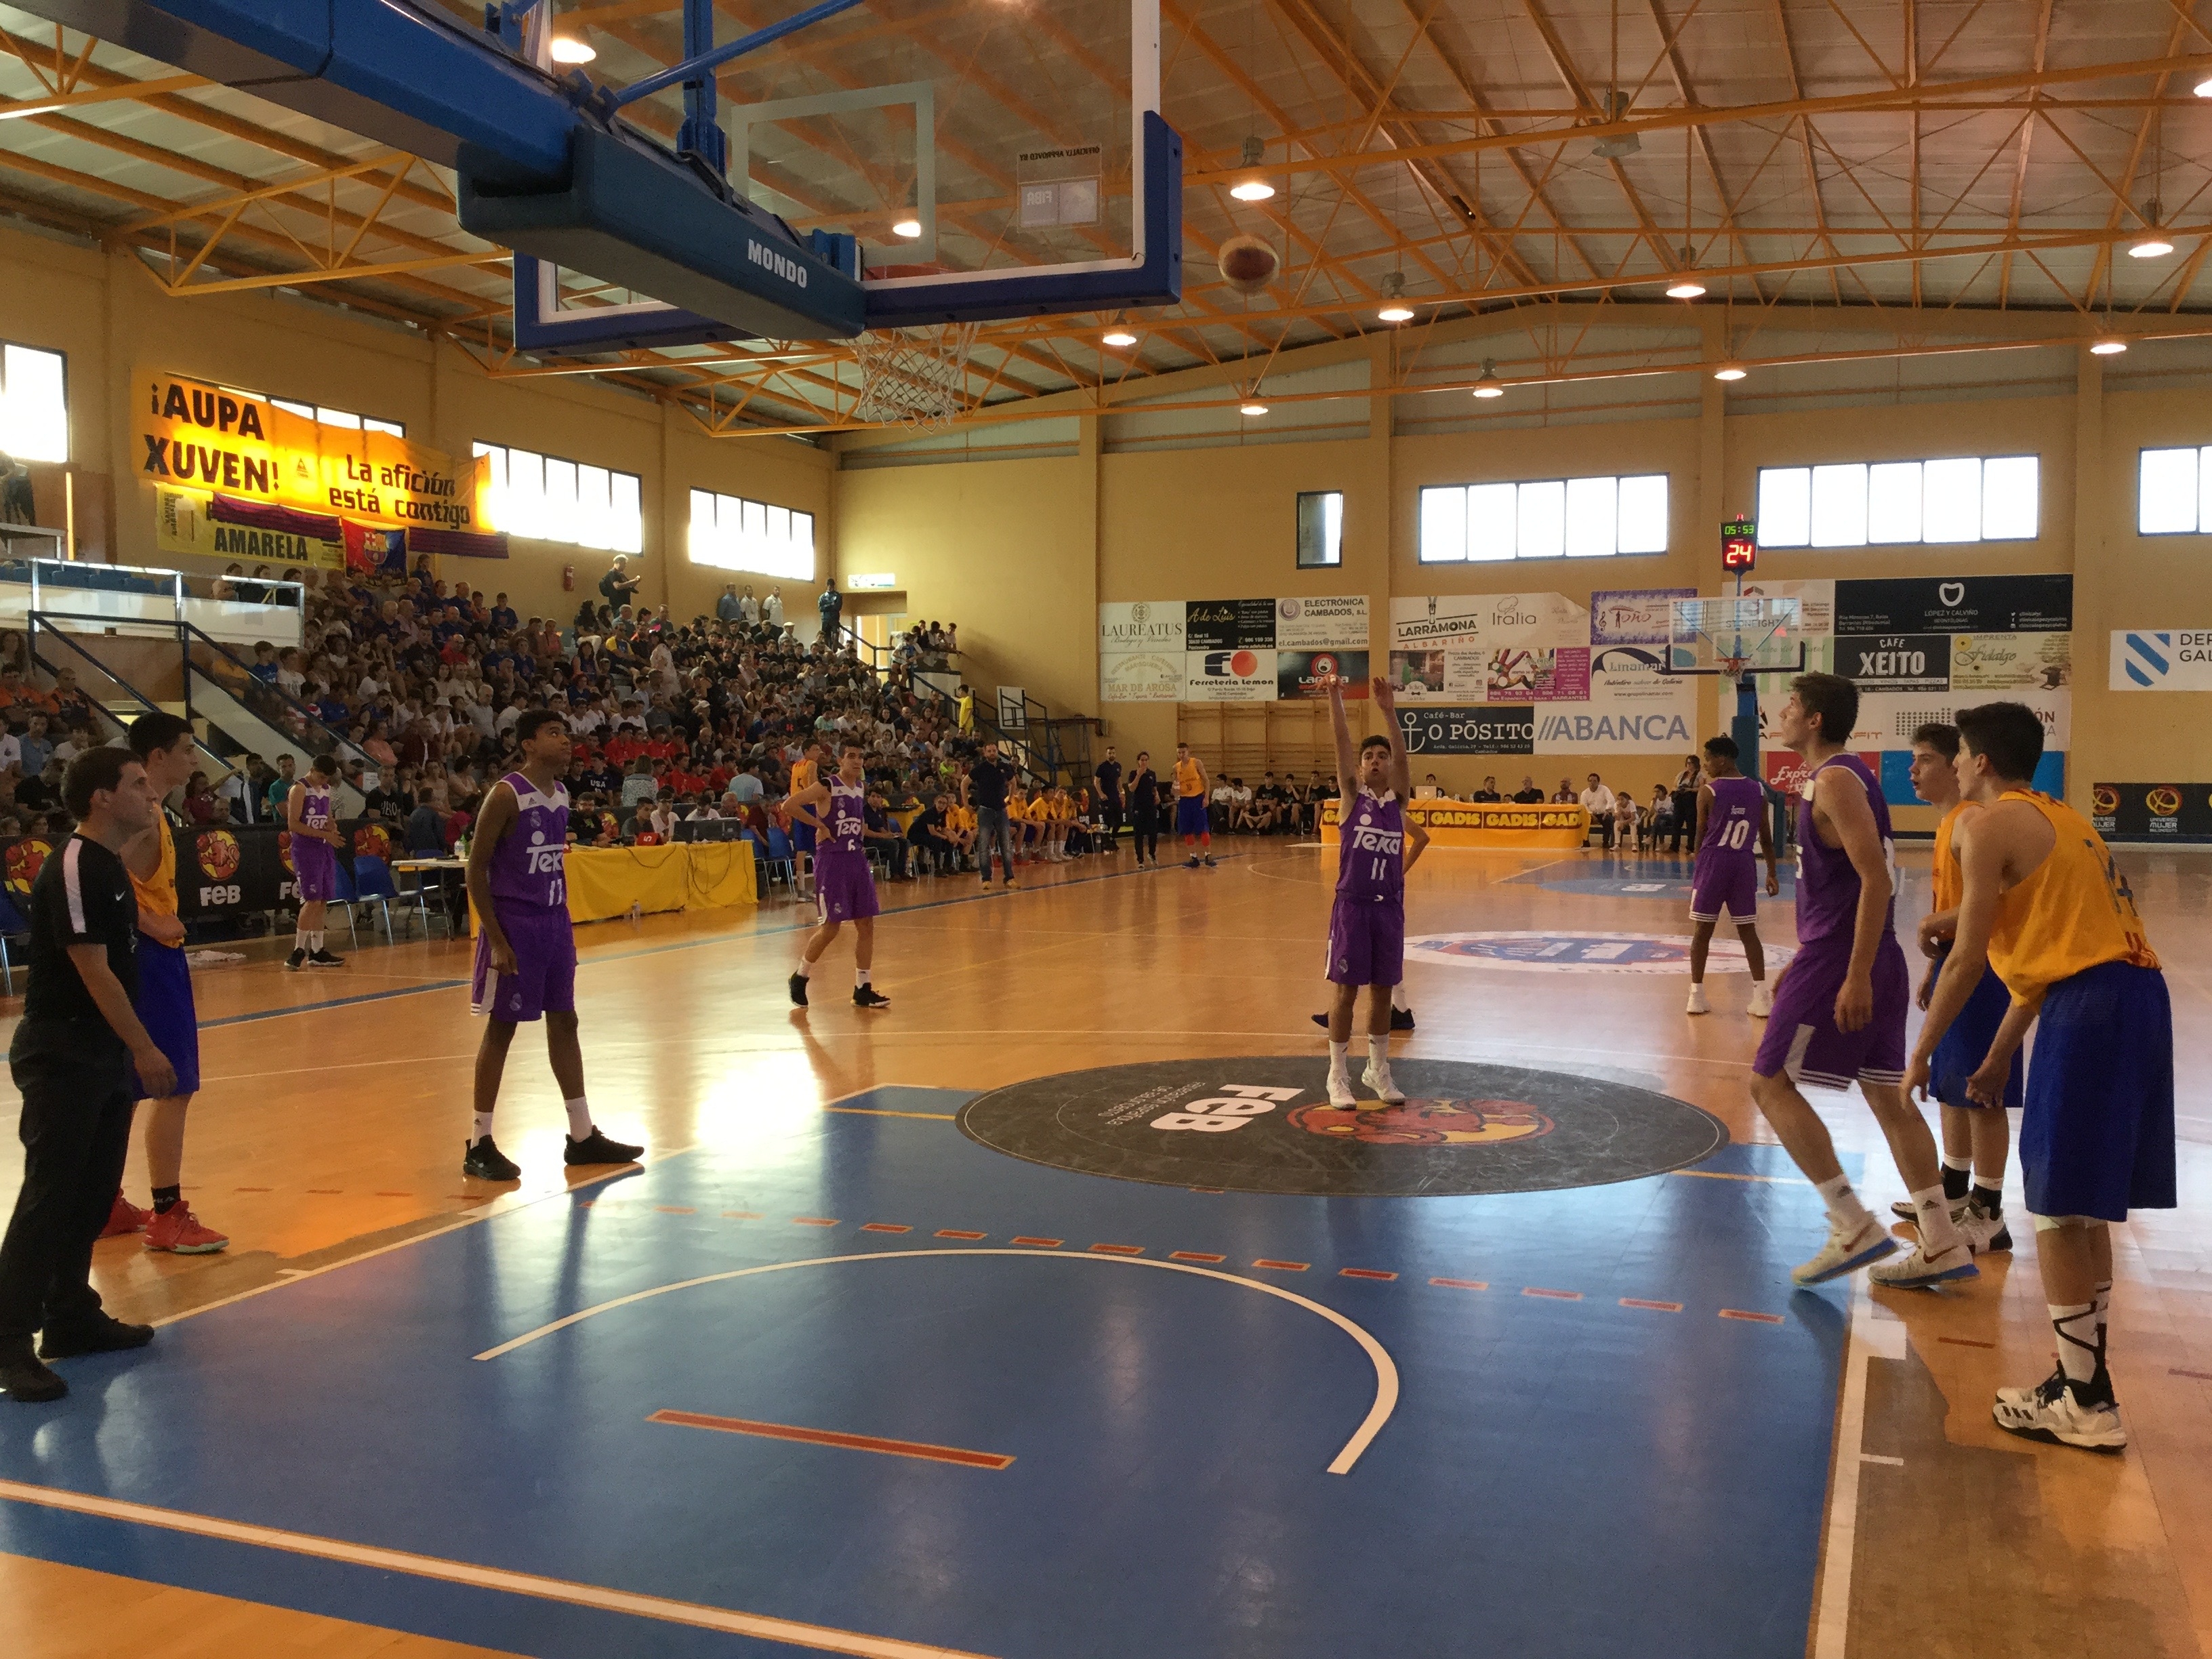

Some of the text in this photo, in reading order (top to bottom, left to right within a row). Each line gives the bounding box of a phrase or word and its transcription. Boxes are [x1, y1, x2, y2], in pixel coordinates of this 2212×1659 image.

[748, 238, 807, 289] MONDO
[151, 383, 265, 441] ¡AUPA
[144, 434, 279, 493] XUVEN!
[346, 453, 455, 497] La afición
[329, 487, 470, 530] está contigo
[214, 527, 308, 561] AMARELA
[1726, 544, 1753, 564] 24
[1305, 598, 1364, 607] ELECTRÓNICA
[1200, 609, 1211, 621] de
[1212, 607, 1235, 623] Luis
[1305, 609, 1354, 617] CAMBADOS,
[1492, 612, 1536, 626] Italia
[1102, 622, 1183, 636] LAUREATUS
[1398, 619, 1477, 638] LARRAMONA
[1278, 638, 1368, 647] el.cambados@gmail.com
[1404, 635, 1475, 650] ALBARIÑO
[1879, 638, 1906, 649] CAFE
[1858, 651, 1925, 676] XEITO
[1954, 644, 2017, 666] Fidalgo
[1108, 683, 1177, 692] MAR DE AROSA
[1428, 724, 1443, 741] O
[590, 780, 606, 788] USA
[1431, 812, 1481, 825] GADIS
[1486, 813, 1538, 827] GADIS
[1353, 825, 1402, 855] Teka
[1717, 819, 1749, 850] 10
[848, 838, 855, 851] 6
[526, 844, 564, 874] Tek
[1370, 857, 1387, 880] 11
[548, 878, 563, 907] 11
